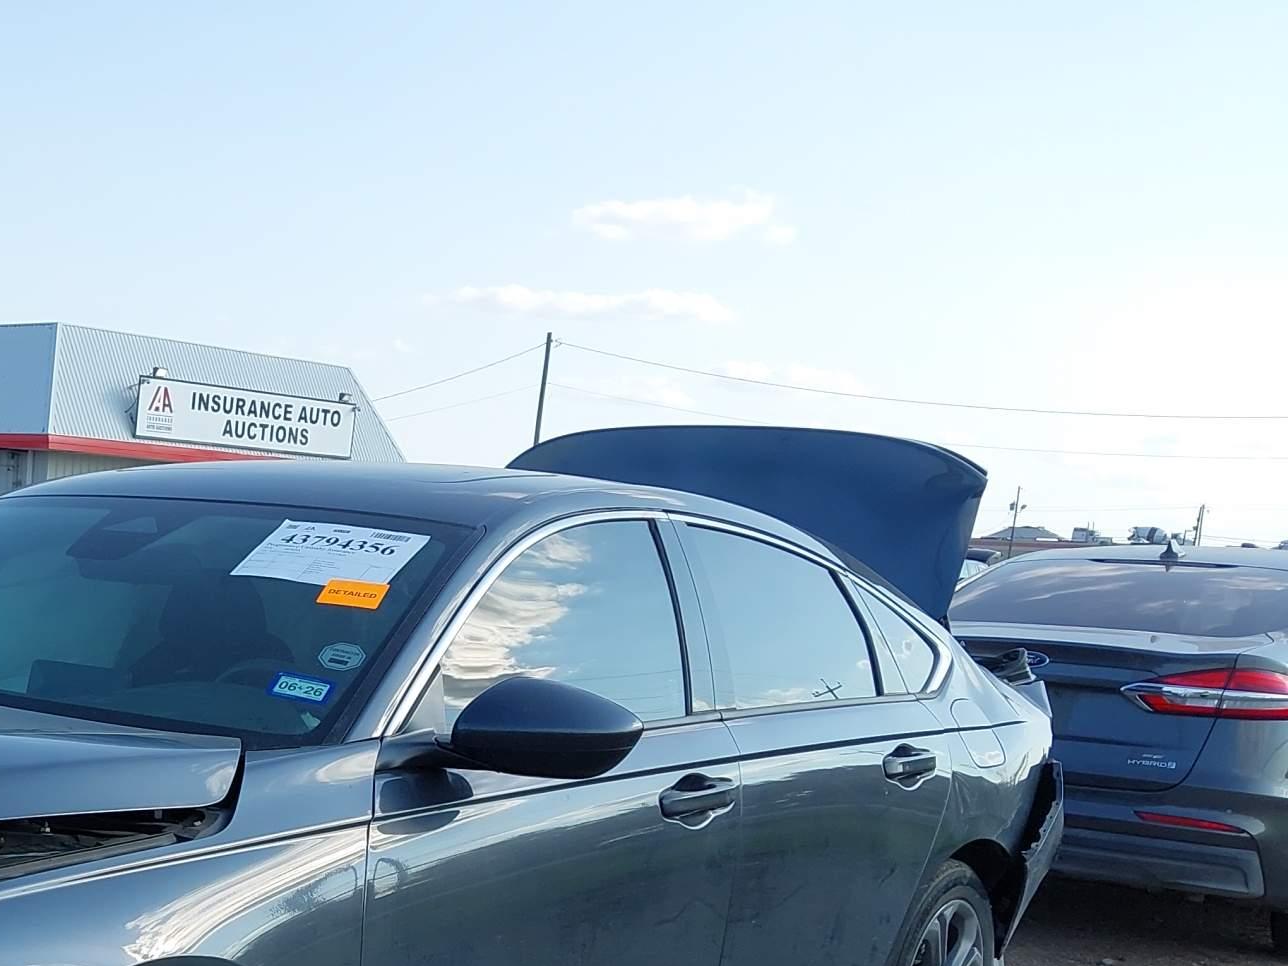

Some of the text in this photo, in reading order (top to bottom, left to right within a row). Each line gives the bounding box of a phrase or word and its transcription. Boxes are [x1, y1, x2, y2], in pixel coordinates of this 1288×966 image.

[191, 391, 341, 427] INSURANCE AUTO
[222, 419, 309, 446] AUCTIONS
[280, 533, 400, 556] 43794356
[328, 588, 378, 600] DETAILED
